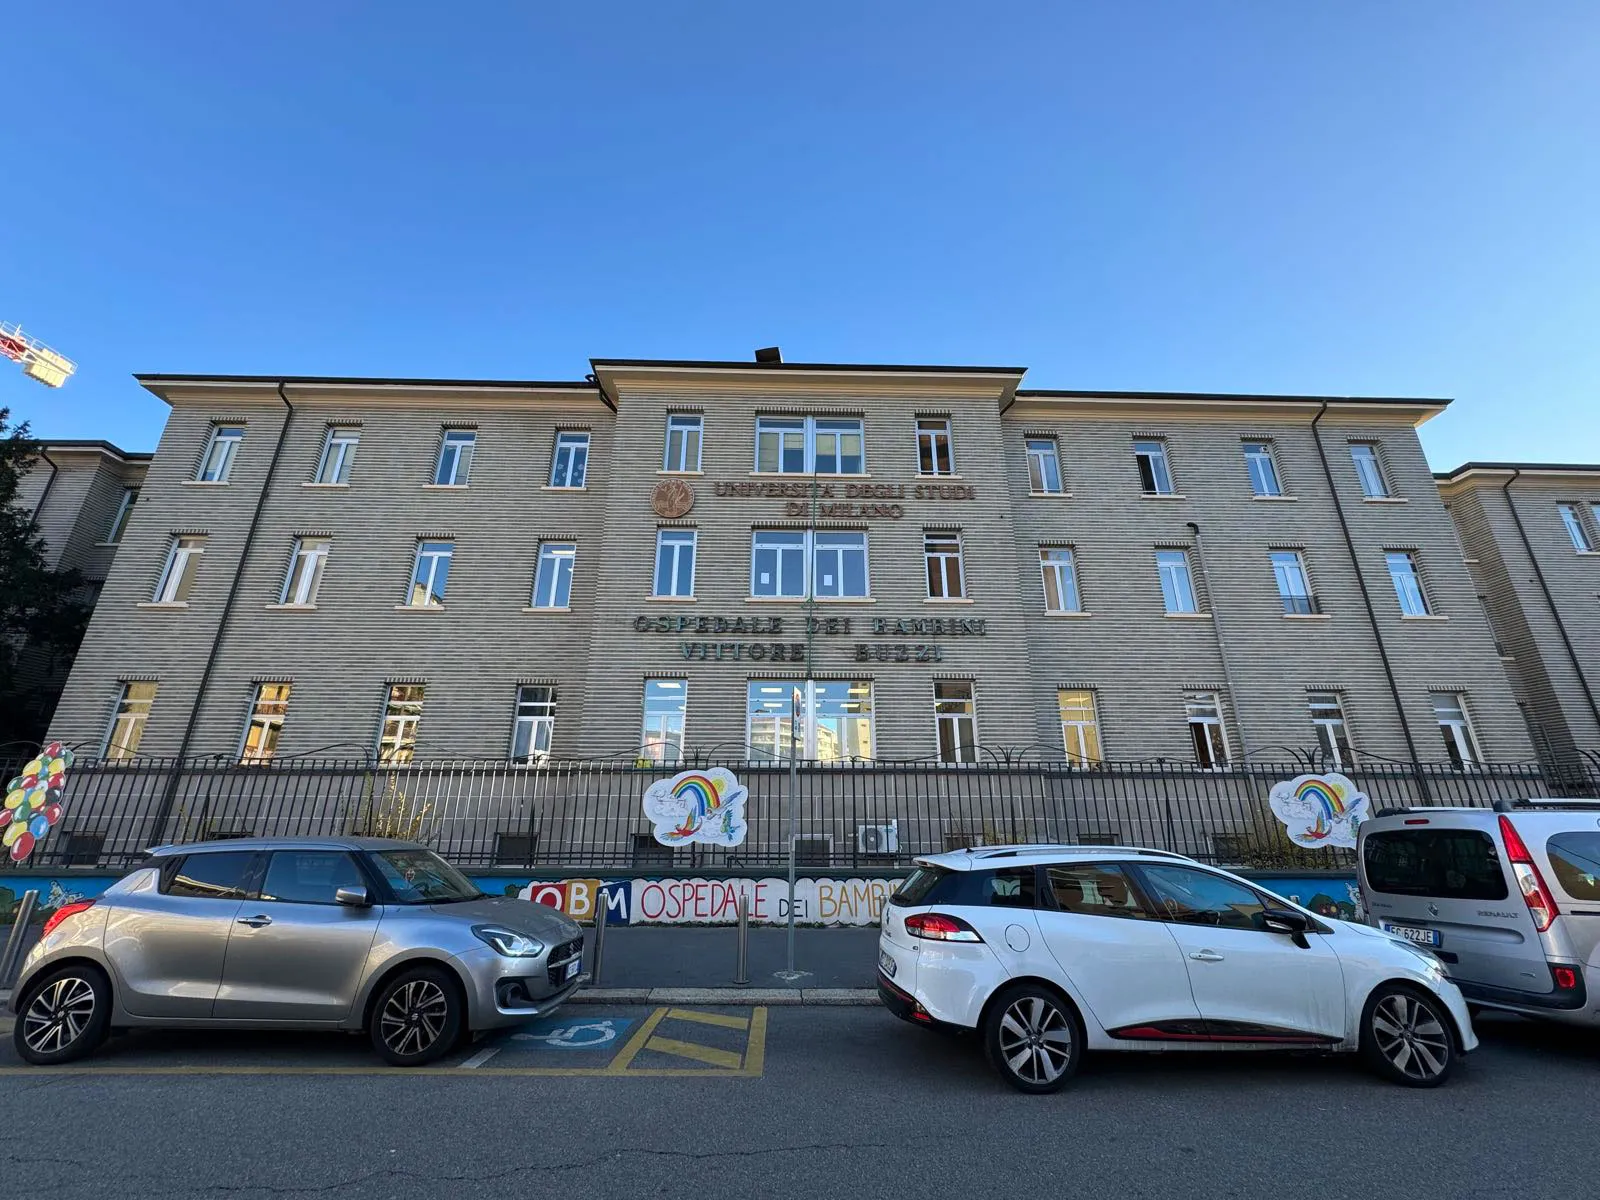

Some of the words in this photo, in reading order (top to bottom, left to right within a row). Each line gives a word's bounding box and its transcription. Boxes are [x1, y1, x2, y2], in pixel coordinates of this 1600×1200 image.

[845, 484, 905, 499] DEGLI
[914, 484, 976, 500] STUDI
[785, 502, 809, 517] DI
[820, 503, 904, 518] MILANO
[633, 615, 784, 634] OSPEDALE
[805, 616, 851, 634] DEI
[872, 617, 987, 636] BAMBINI
[681, 642, 805, 661] VITTORE
[855, 643, 942, 662] BUZZI
[535, 882, 628, 919] OBM
[779, 898, 808, 918] DEI
[819, 883, 898, 918] BAMB
